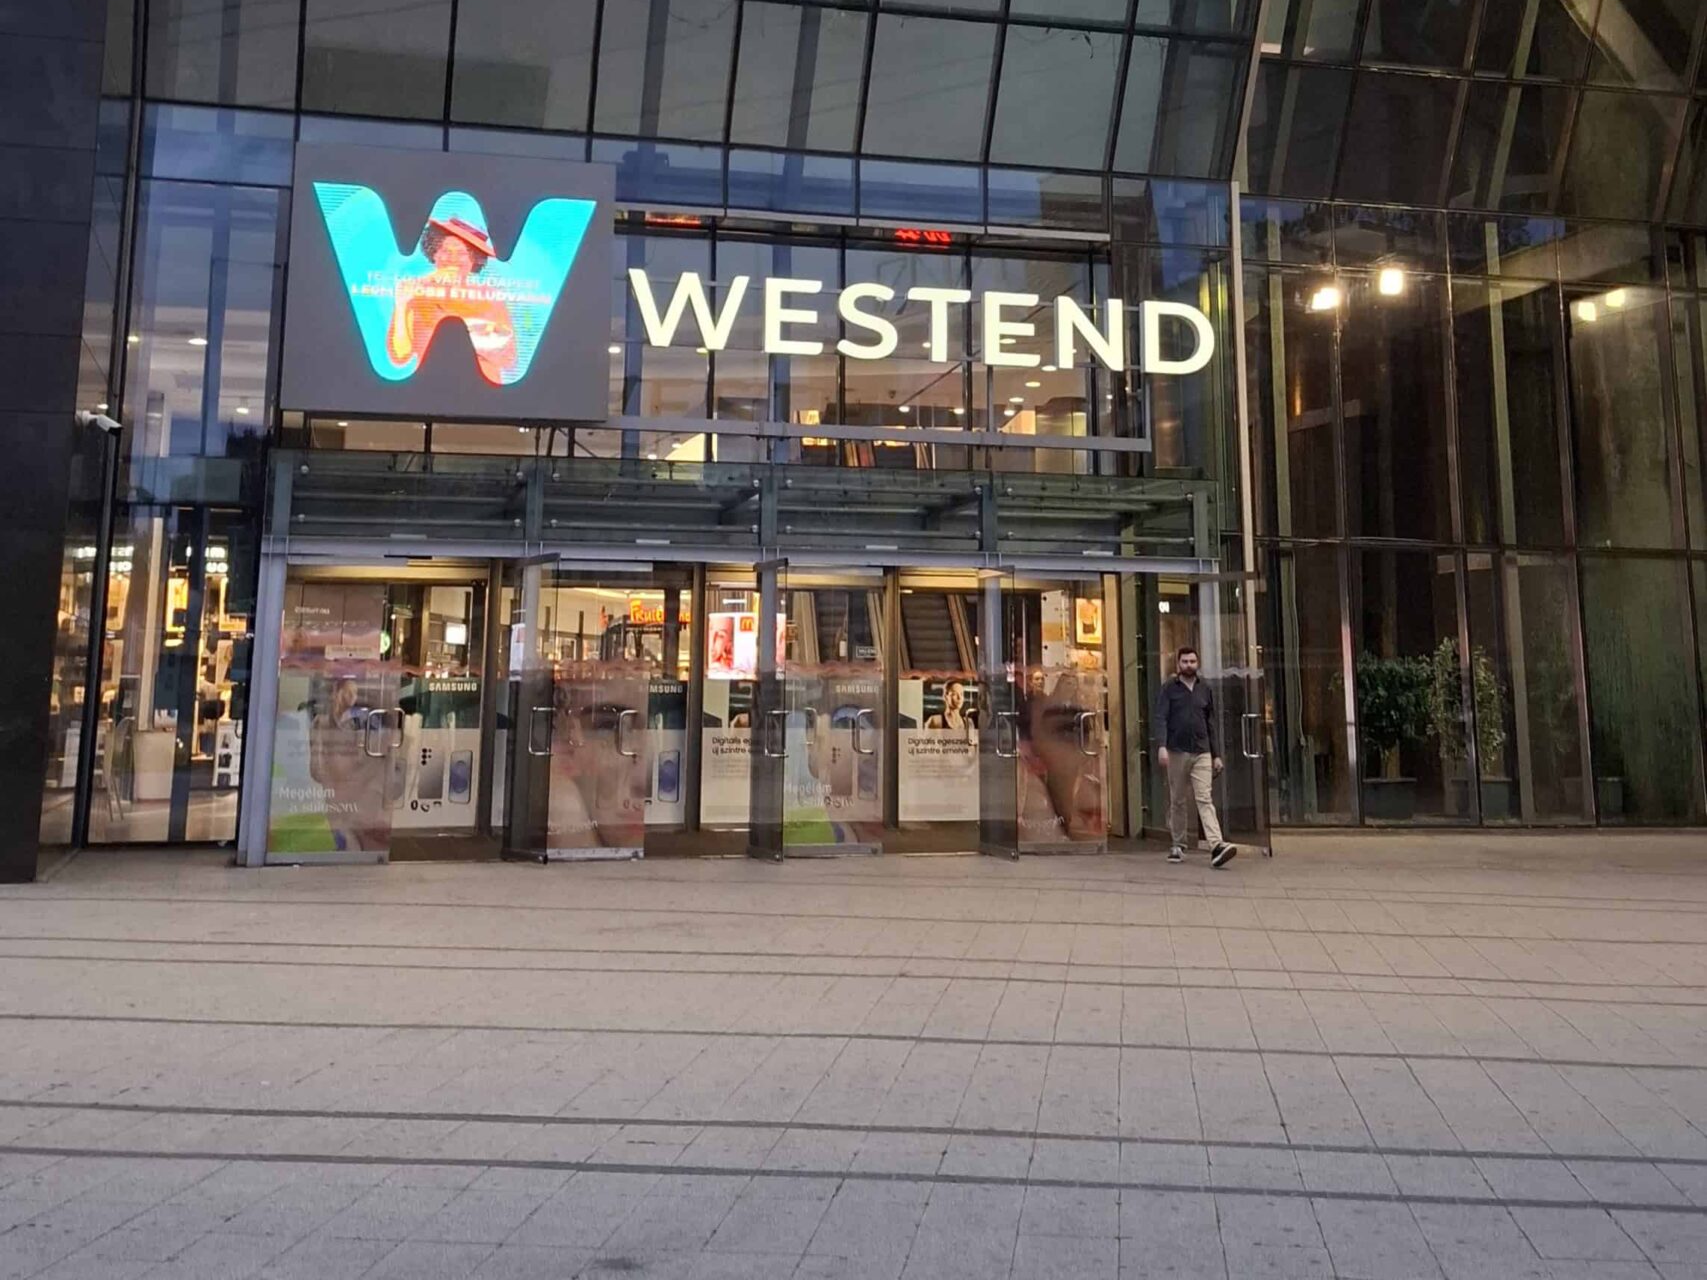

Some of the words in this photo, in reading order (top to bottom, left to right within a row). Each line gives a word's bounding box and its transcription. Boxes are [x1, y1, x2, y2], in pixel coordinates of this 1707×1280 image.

[627, 267, 1216, 375] WESTEND
[428, 682, 477, 692] SAMSUNG
[645, 684, 684, 694] MSUNG
[835, 685, 880, 694] SAMSUNG
